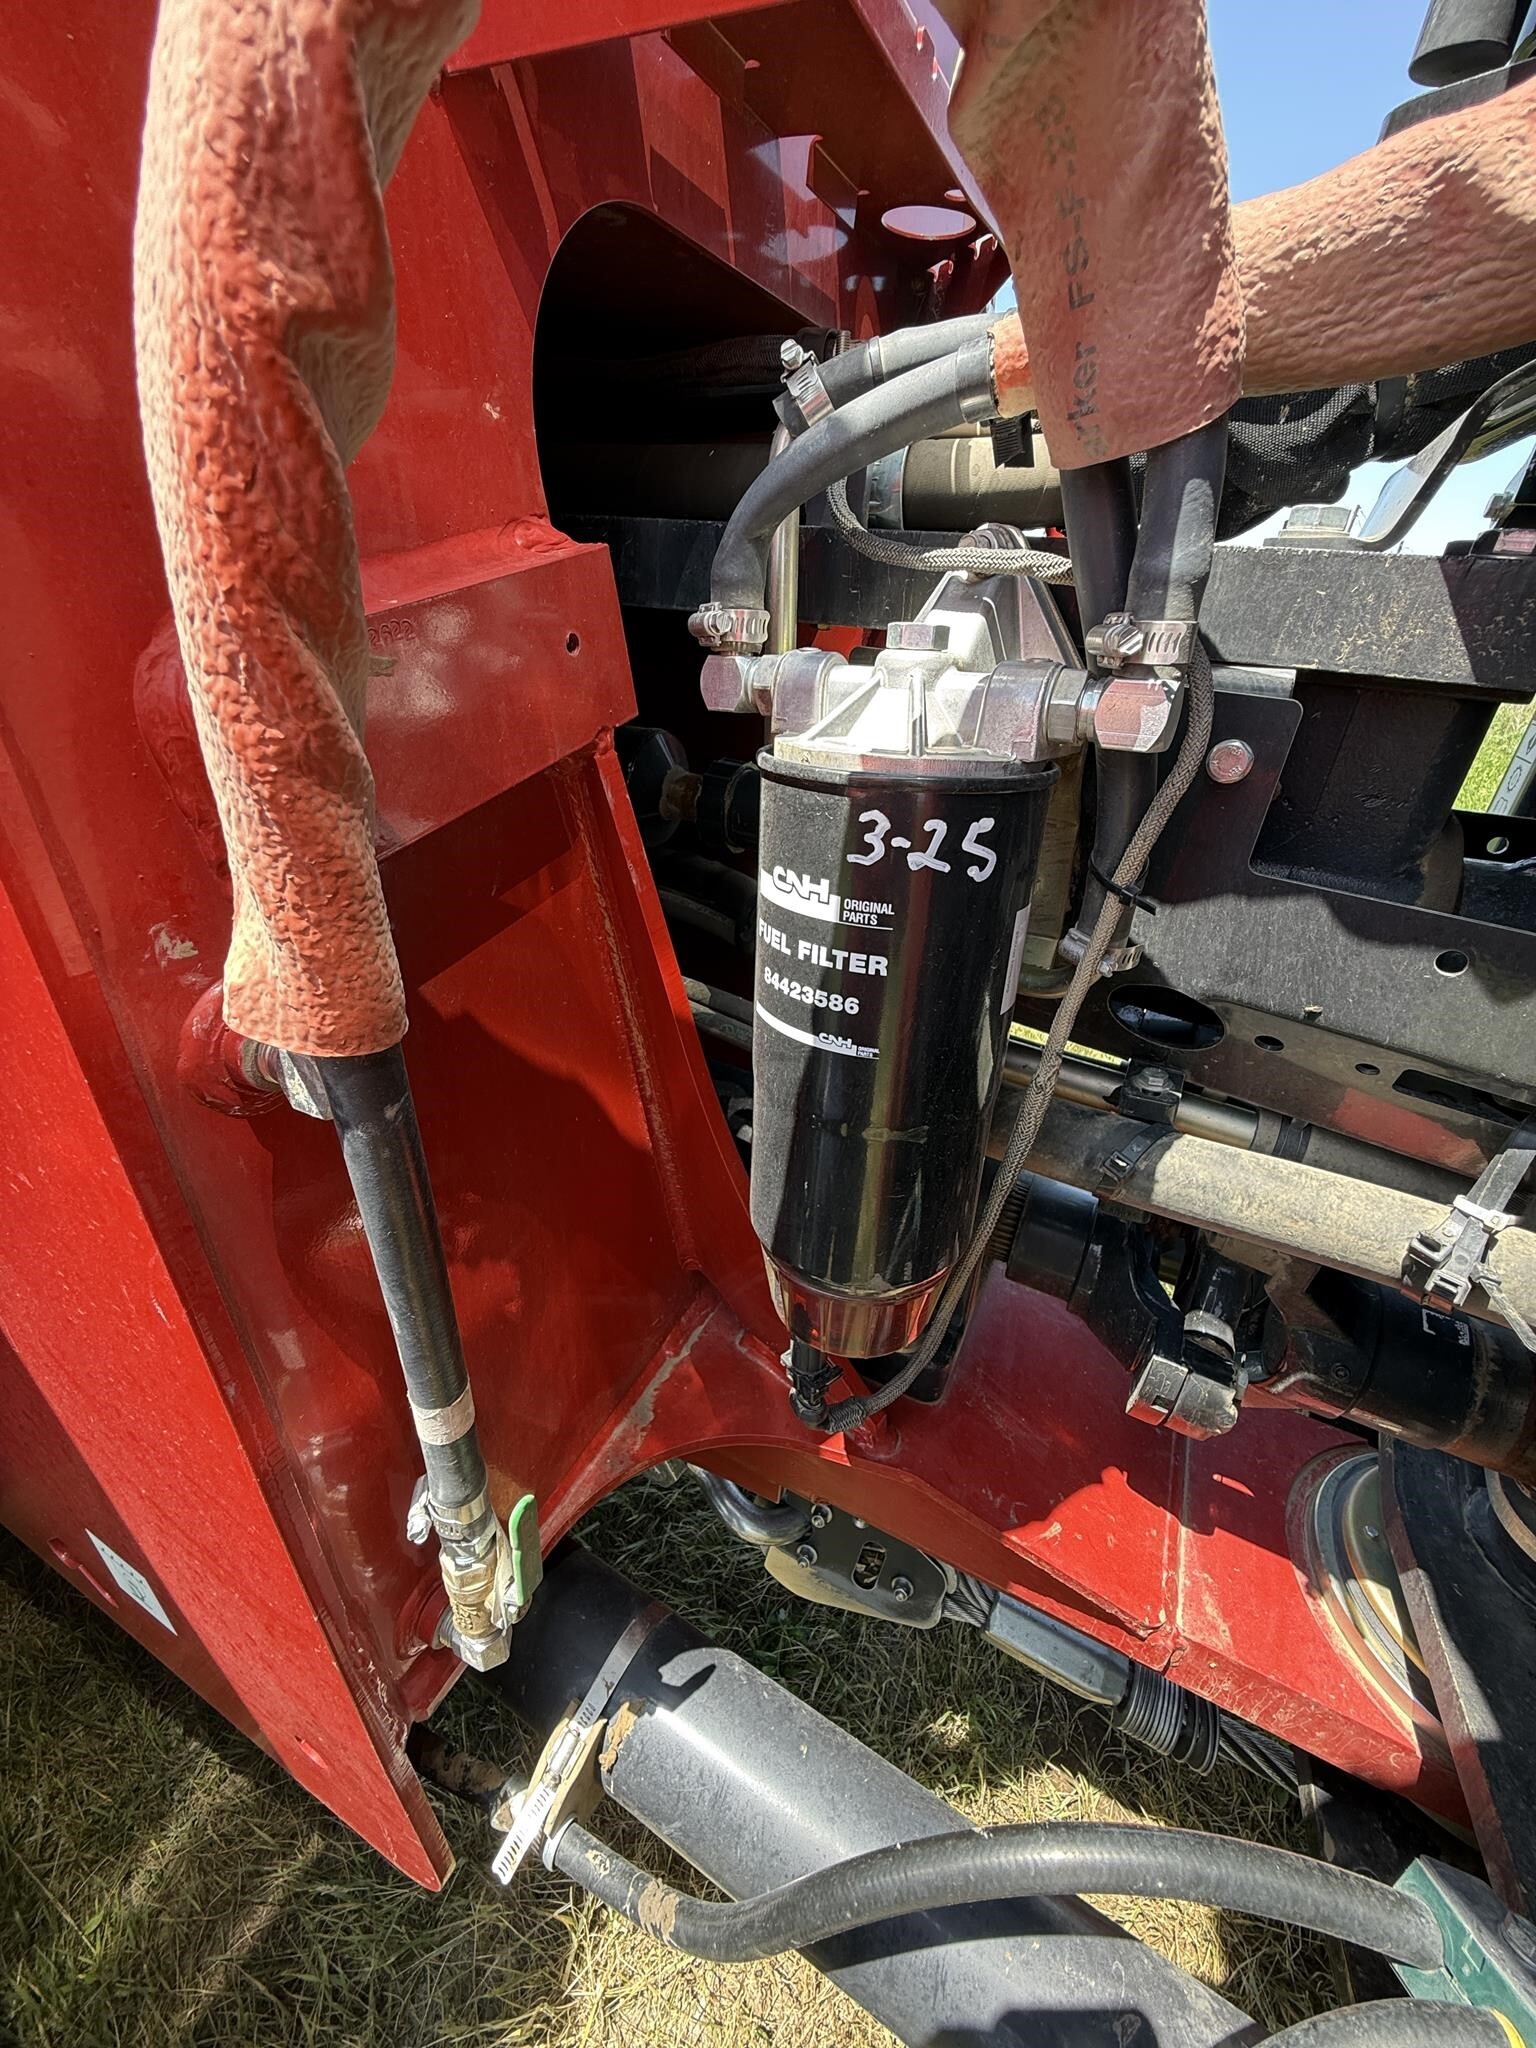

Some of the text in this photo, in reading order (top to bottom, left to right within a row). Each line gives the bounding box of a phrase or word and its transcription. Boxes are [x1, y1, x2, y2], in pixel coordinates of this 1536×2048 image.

[847, 809, 997, 883] 3-25
[772, 865, 830, 903] CNH
[842, 911, 878, 926] PARTS
[843, 898, 895, 915] ORIGINAL
[758, 917, 889, 977] FUEL FILTER
[764, 966, 860, 1015] 84423586
[818, 1032, 852, 1049] CNH
